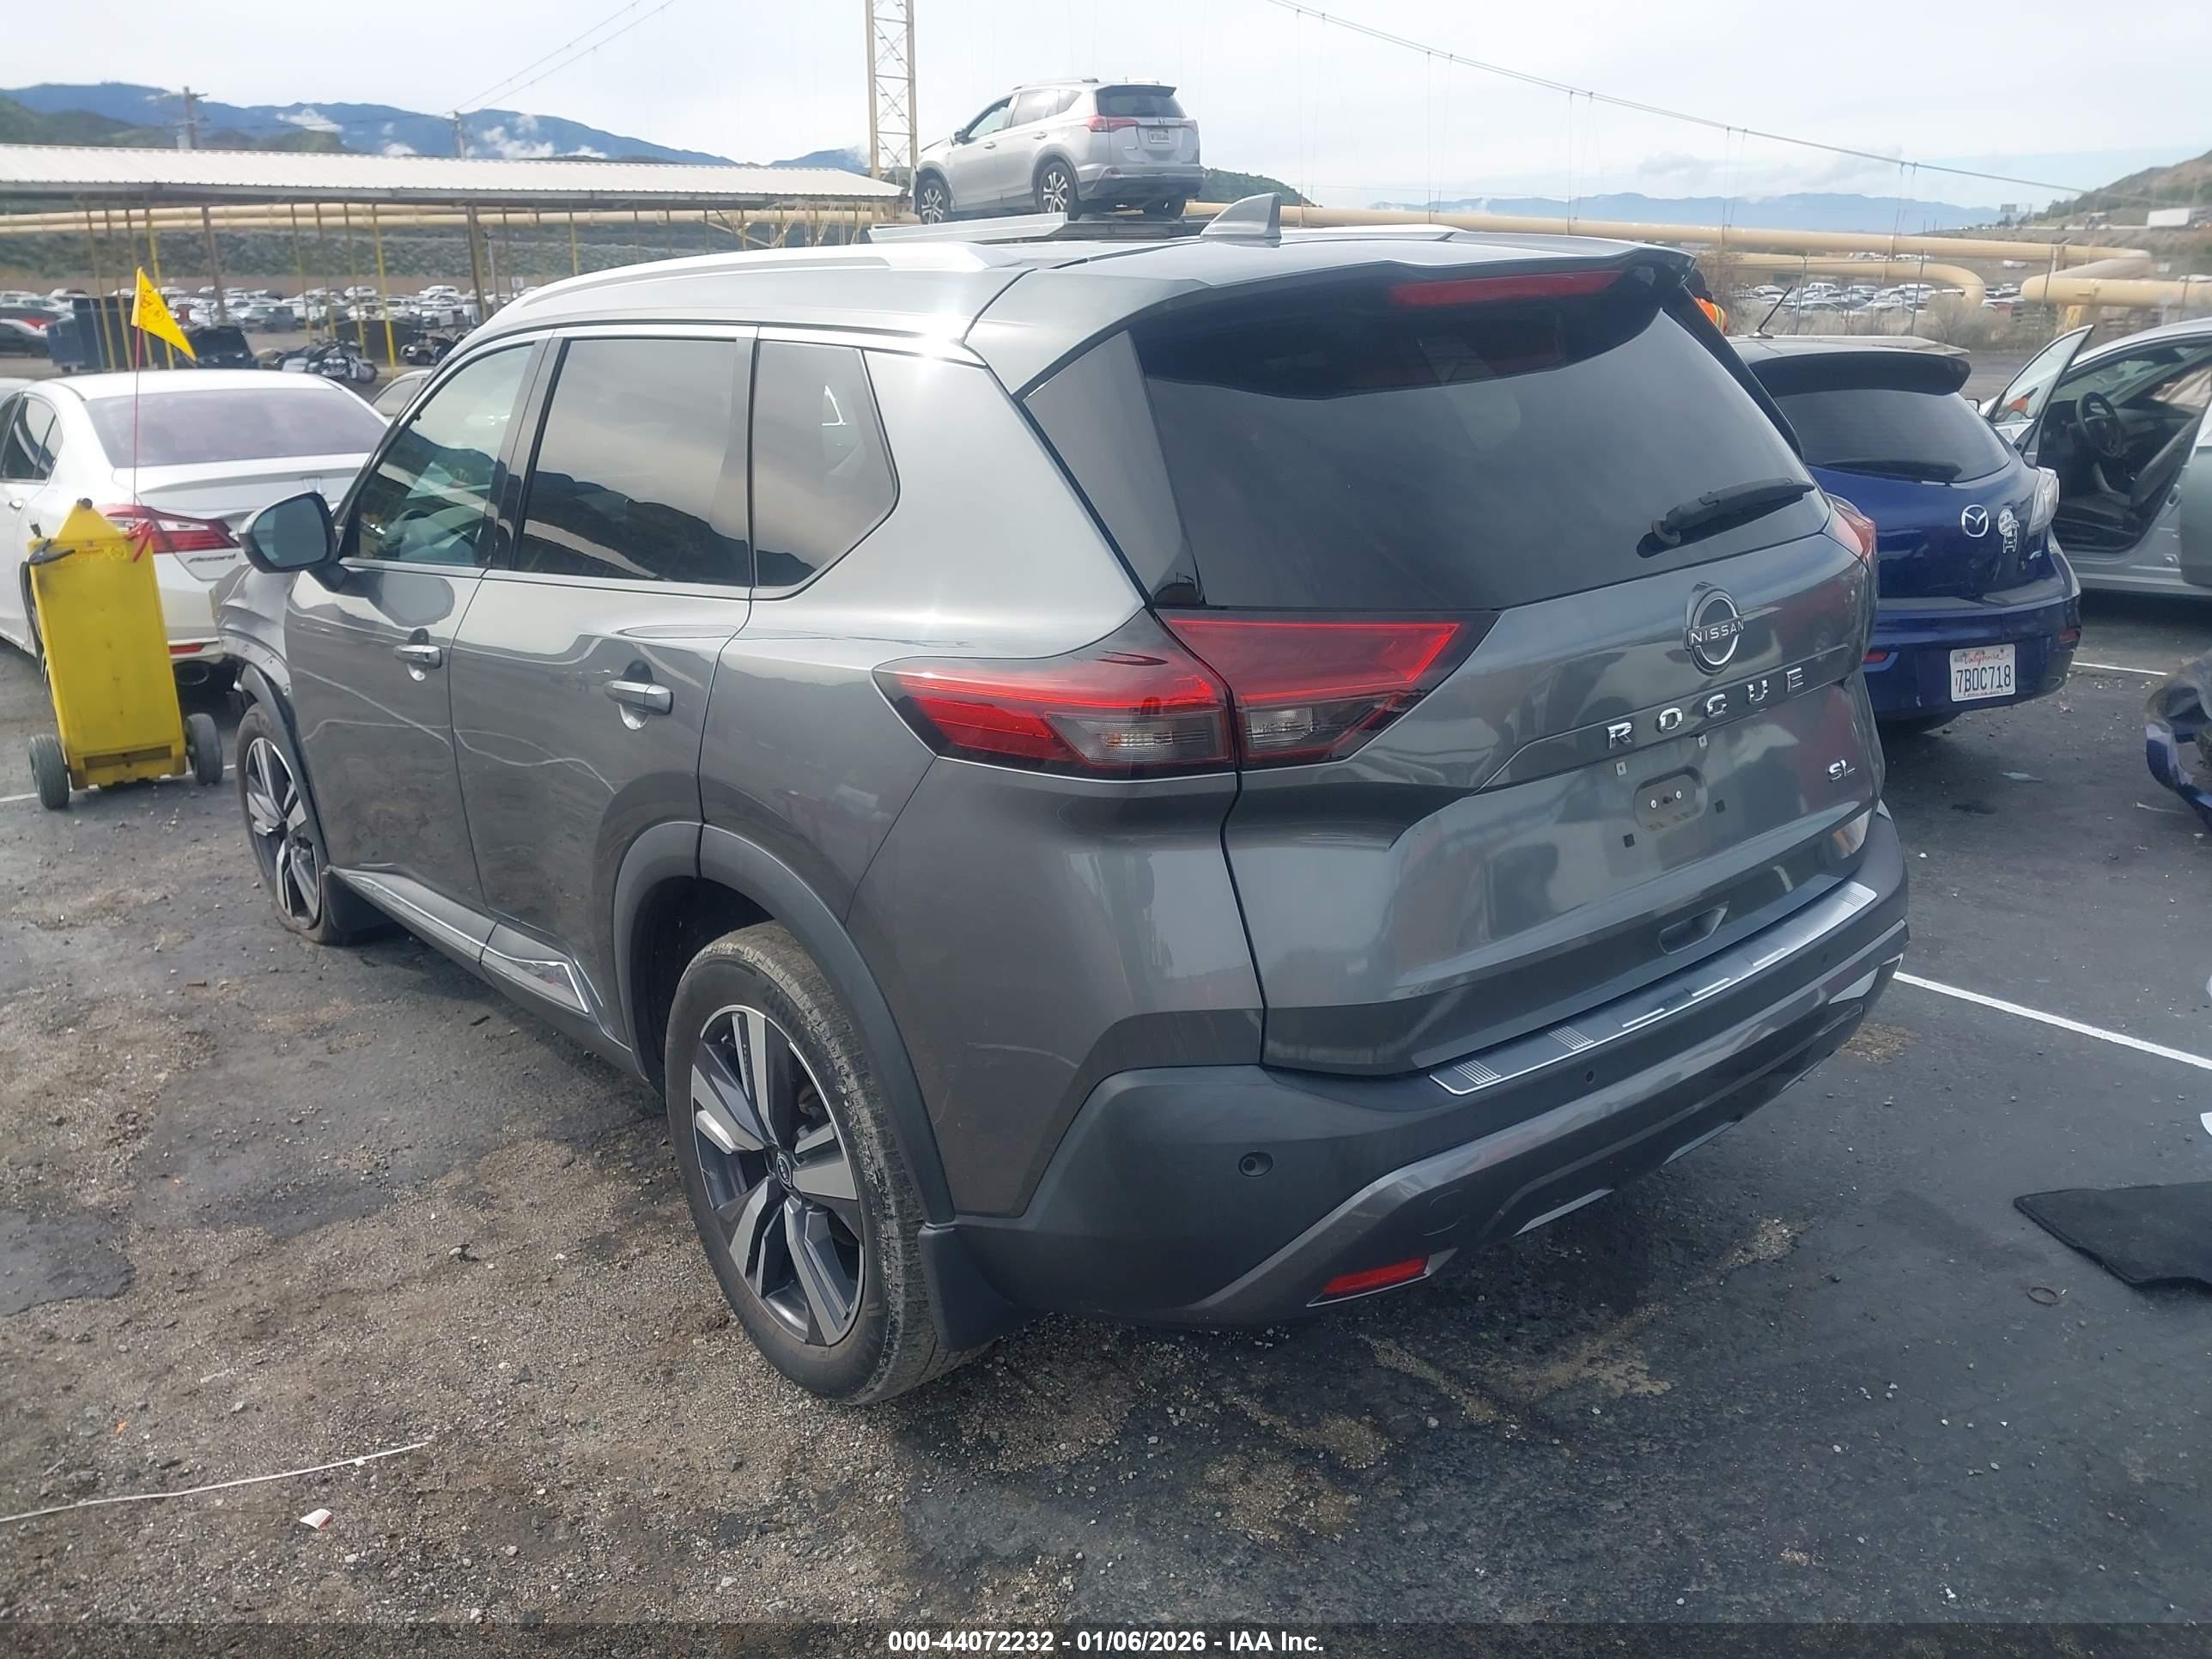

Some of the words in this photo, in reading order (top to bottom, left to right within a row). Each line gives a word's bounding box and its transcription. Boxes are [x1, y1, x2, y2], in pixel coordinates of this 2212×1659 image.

[1690, 619, 1746, 646] NISSAN
[1956, 665, 2011, 694] 7BOC718
[1607, 666, 1804, 750] ROGUE
[1827, 758, 1856, 781] SL
